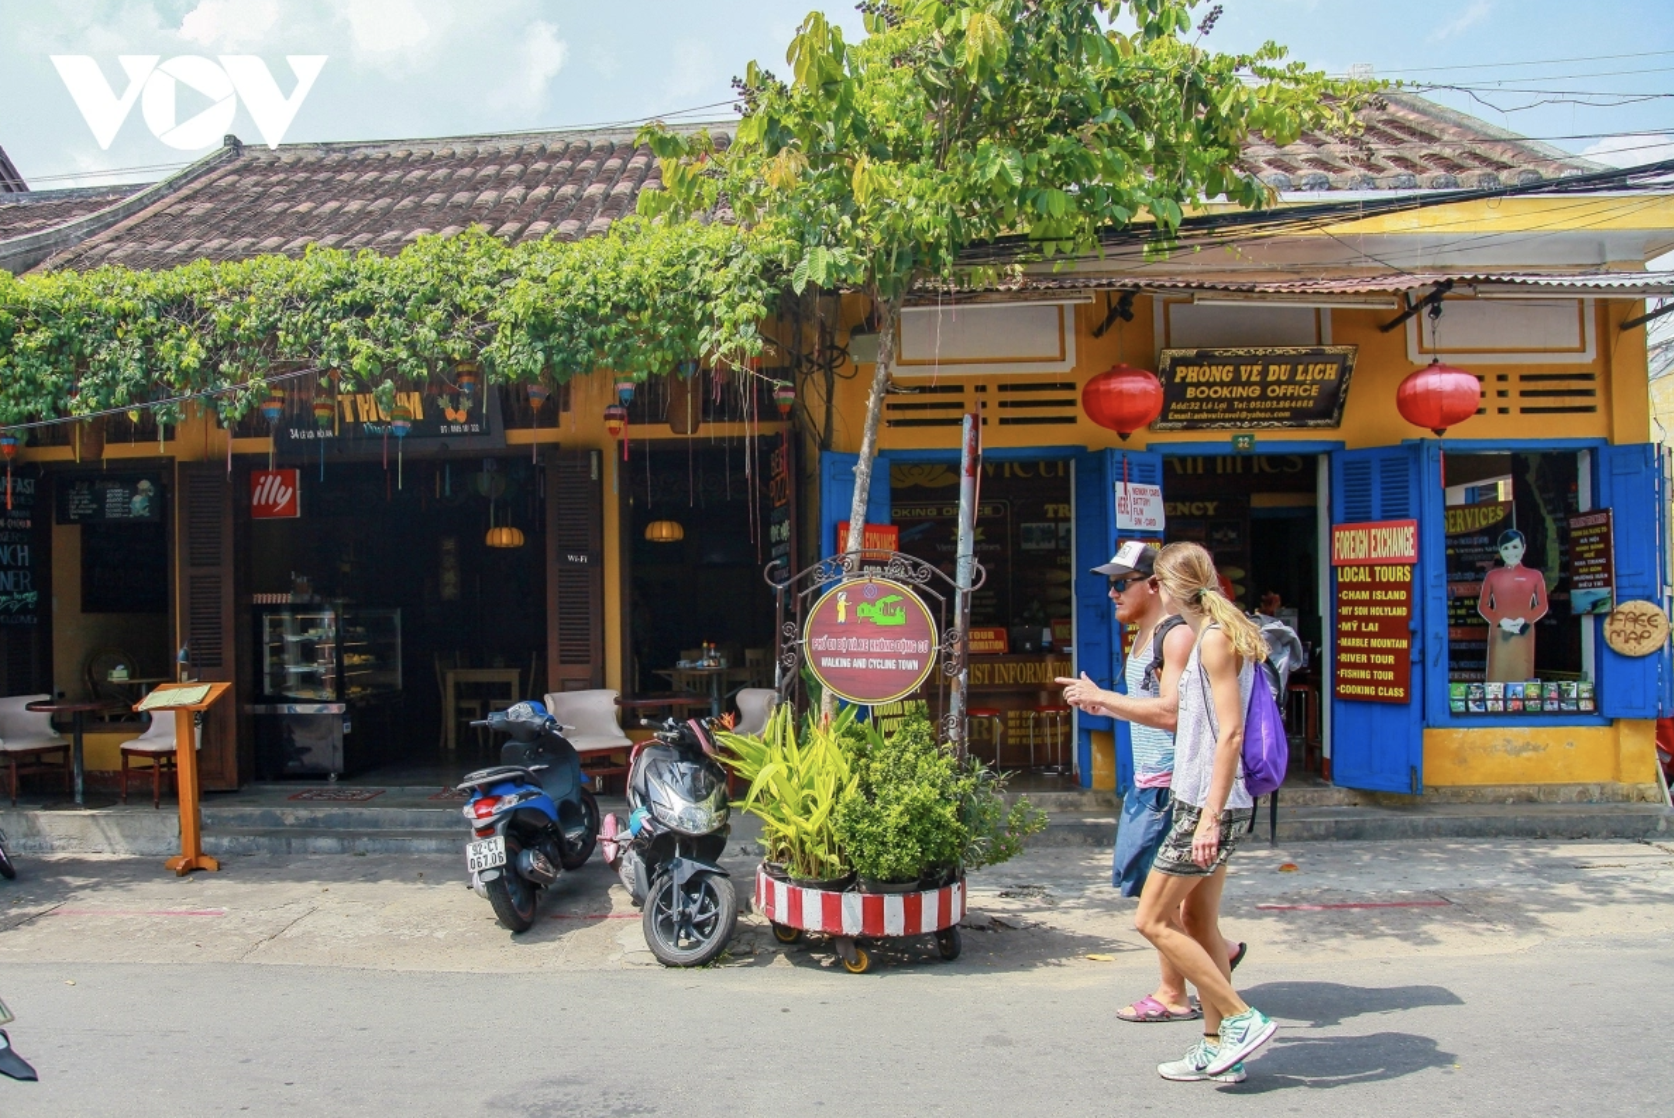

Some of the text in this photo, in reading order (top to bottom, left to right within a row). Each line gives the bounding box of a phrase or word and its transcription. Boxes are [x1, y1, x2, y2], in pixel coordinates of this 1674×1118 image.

[1174, 361, 1339, 384] PHÒNG VÉ DU LỊCH
[1186, 384, 1320, 398] BOOKING OFFICE
[252, 475, 293, 512] illy
[1334, 526, 1414, 560] FOREIGN EXCHANGE
[1338, 566, 1411, 582] LOCAL TOURS
[1372, 590, 1407, 600] ISLAND
[1369, 606, 1407, 616] HOLYLAND
[1361, 623, 1379, 632] LAI
[870, 638, 894, 652] KHÔNG
[1340, 638, 1408, 649] MARBLE MOUNTAIN
[1609, 630, 1652, 647] MAP
[821, 657, 919, 671] WALKING AND CYCLING TOWN
[1340, 653, 1395, 665] RIVER TOUR
[1341, 669, 1394, 681] FISHING TOUR
[1340, 685, 1405, 697] COOKING CLASS
